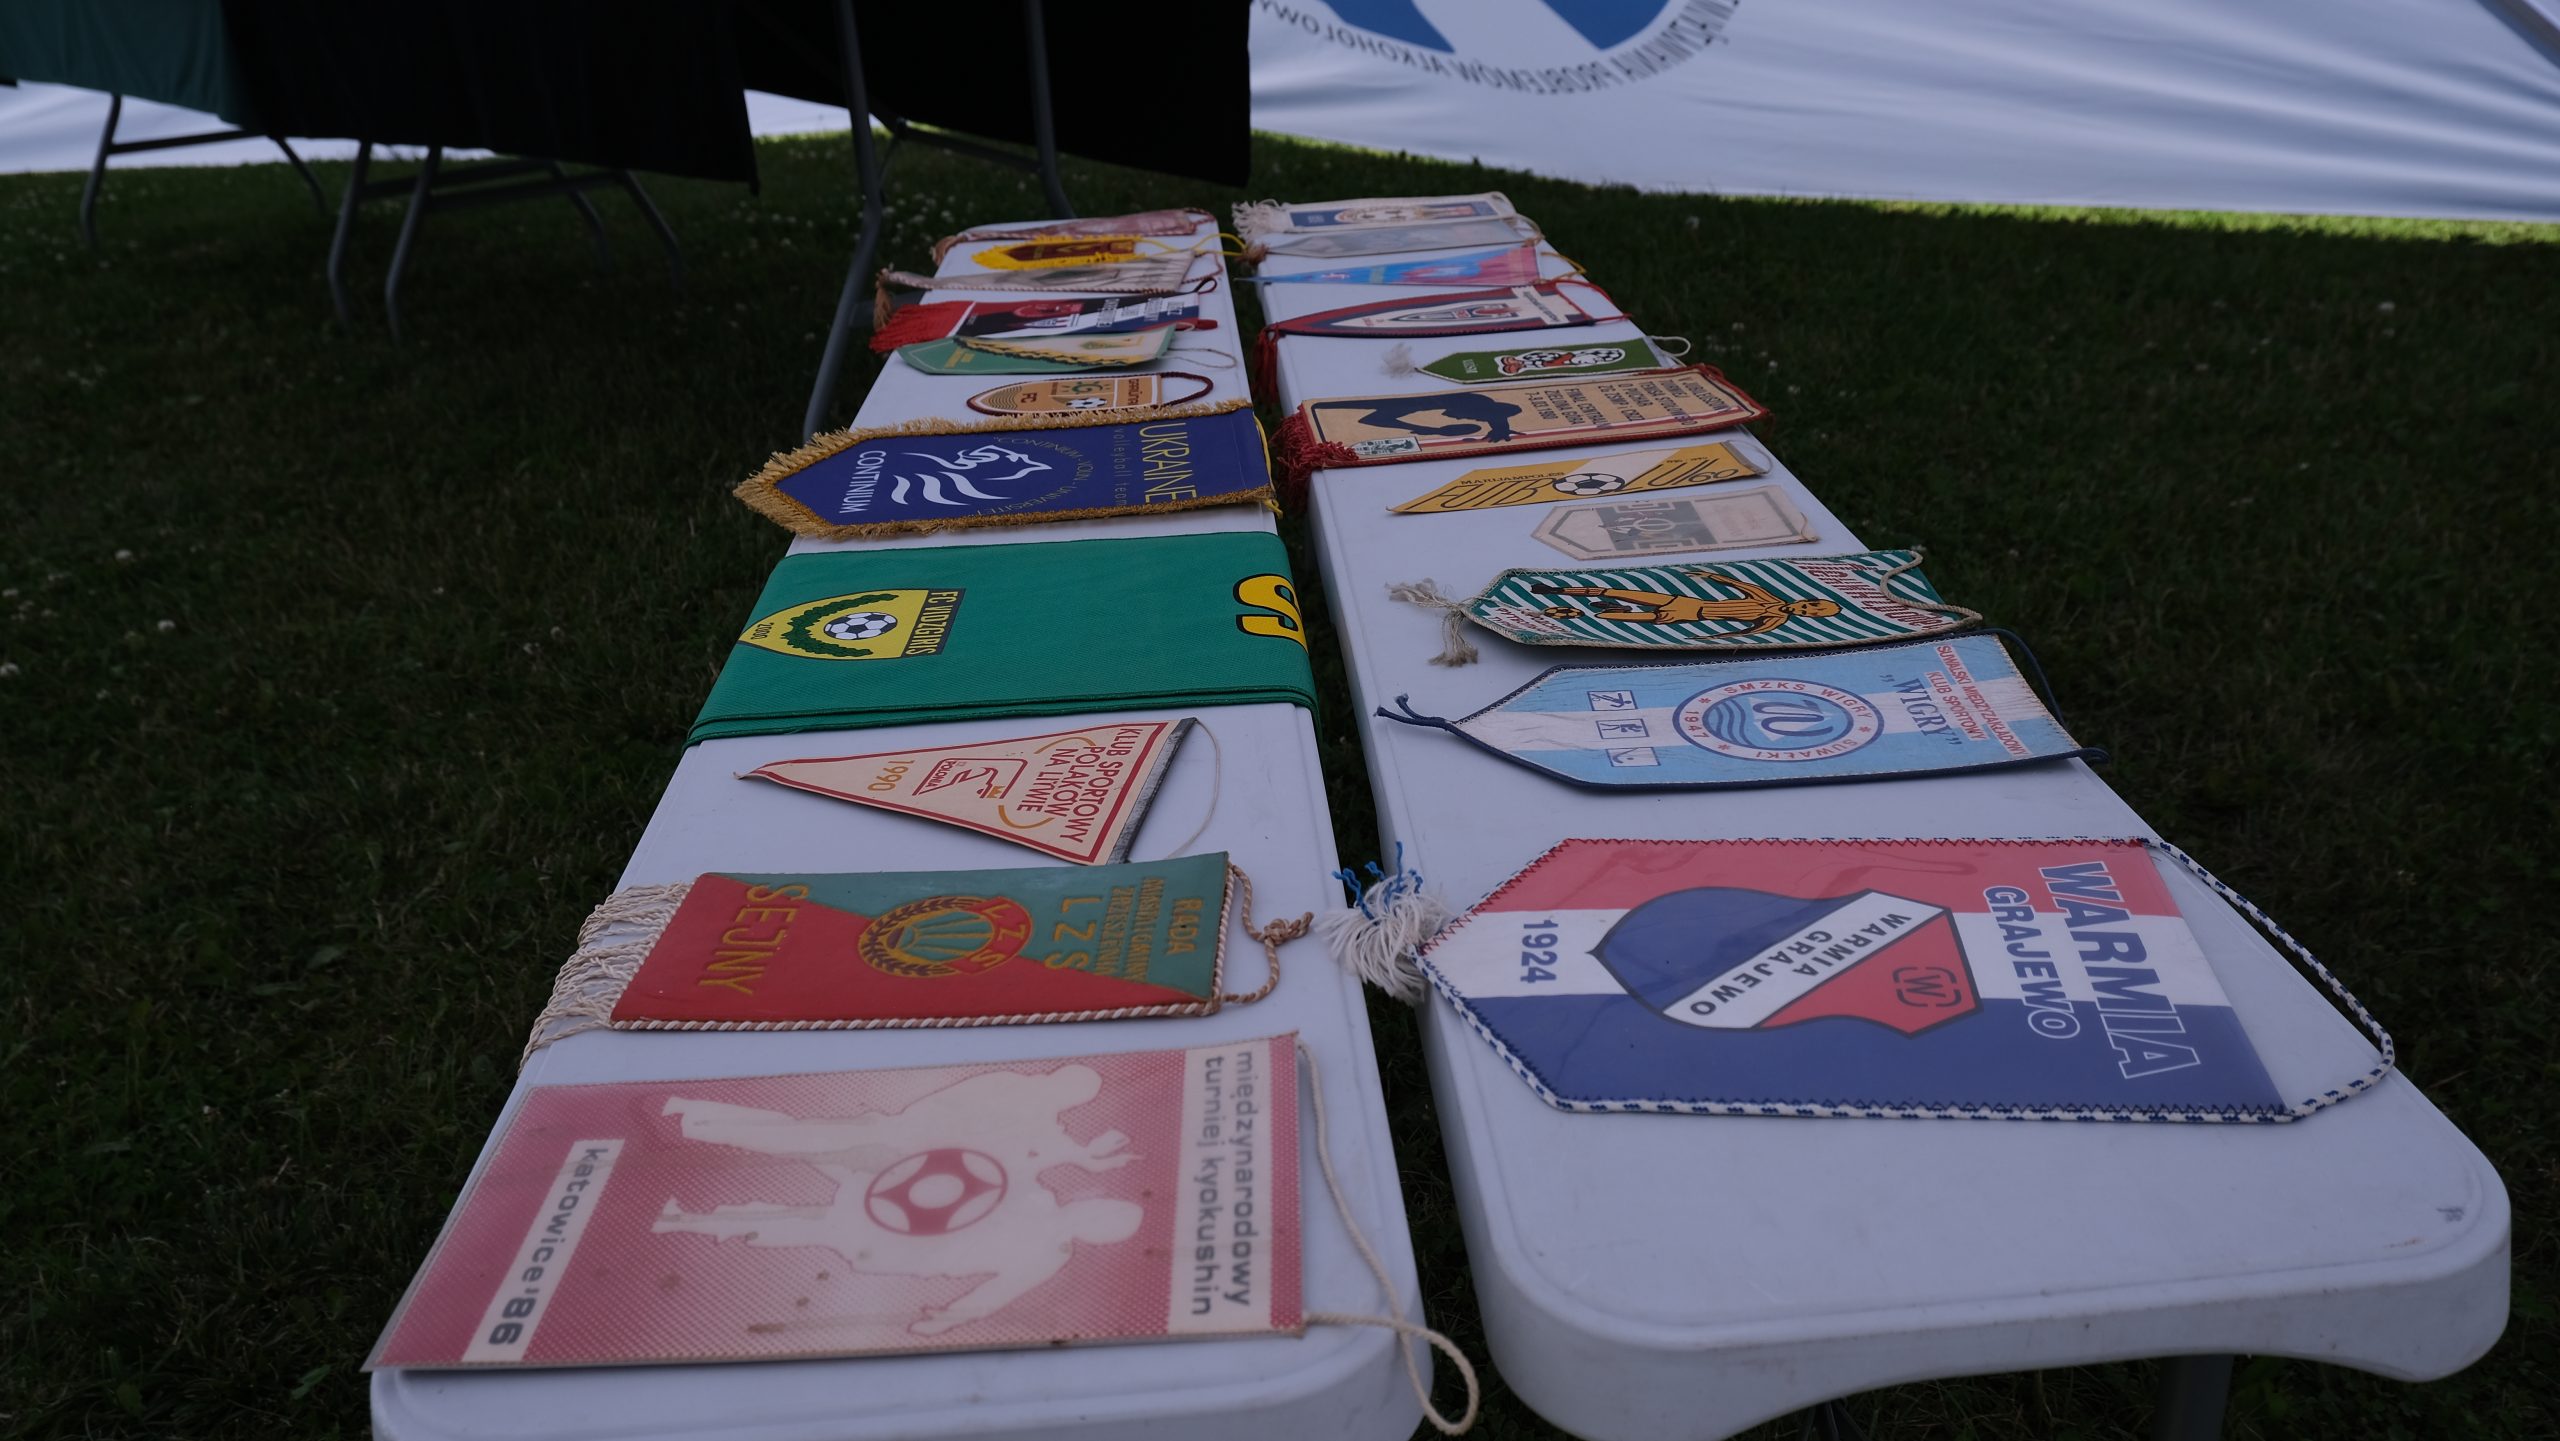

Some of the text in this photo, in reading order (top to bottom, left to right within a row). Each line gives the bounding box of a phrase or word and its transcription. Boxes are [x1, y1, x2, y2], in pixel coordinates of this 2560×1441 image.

[839, 450, 887, 514] CONTINIUM
[1112, 427, 1132, 478] volleyball
[1139, 422, 1197, 504] UKRAINE
[1688, 468, 1740, 482] 60
[753, 621, 775, 640] 2000
[905, 589, 959, 656] FC VIDZGIRIS
[1937, 646, 1974, 684] SUWALSKI
[1685, 709, 1710, 739] 1947
[1722, 680, 1874, 760] SMZKS WIGRY SUWAŁKI
[1926, 671, 1989, 741] KLUB SPORTOWY
[867, 759, 916, 792] 1990
[924, 760, 953, 790] POLONIA
[1016, 748, 1079, 813] NA LITWIE
[1044, 745, 1107, 818] POLAKÓW
[1060, 727, 1143, 843] KLUB SPORTOWY
[698, 882, 810, 997] SEJNY
[1163, 898, 1204, 956] RADA
[1520, 919, 1559, 984] 1924
[1795, 911, 1913, 978] WARMIA
[1689, 929, 1833, 1016] GRAJEWO
[1982, 884, 2081, 1040] GRAJEWO
[2037, 860, 2201, 1079] WARMIA
[1190, 1055, 1225, 1318] turniej kyokushin
[1222, 1050, 1254, 1308] międzynarodowy
